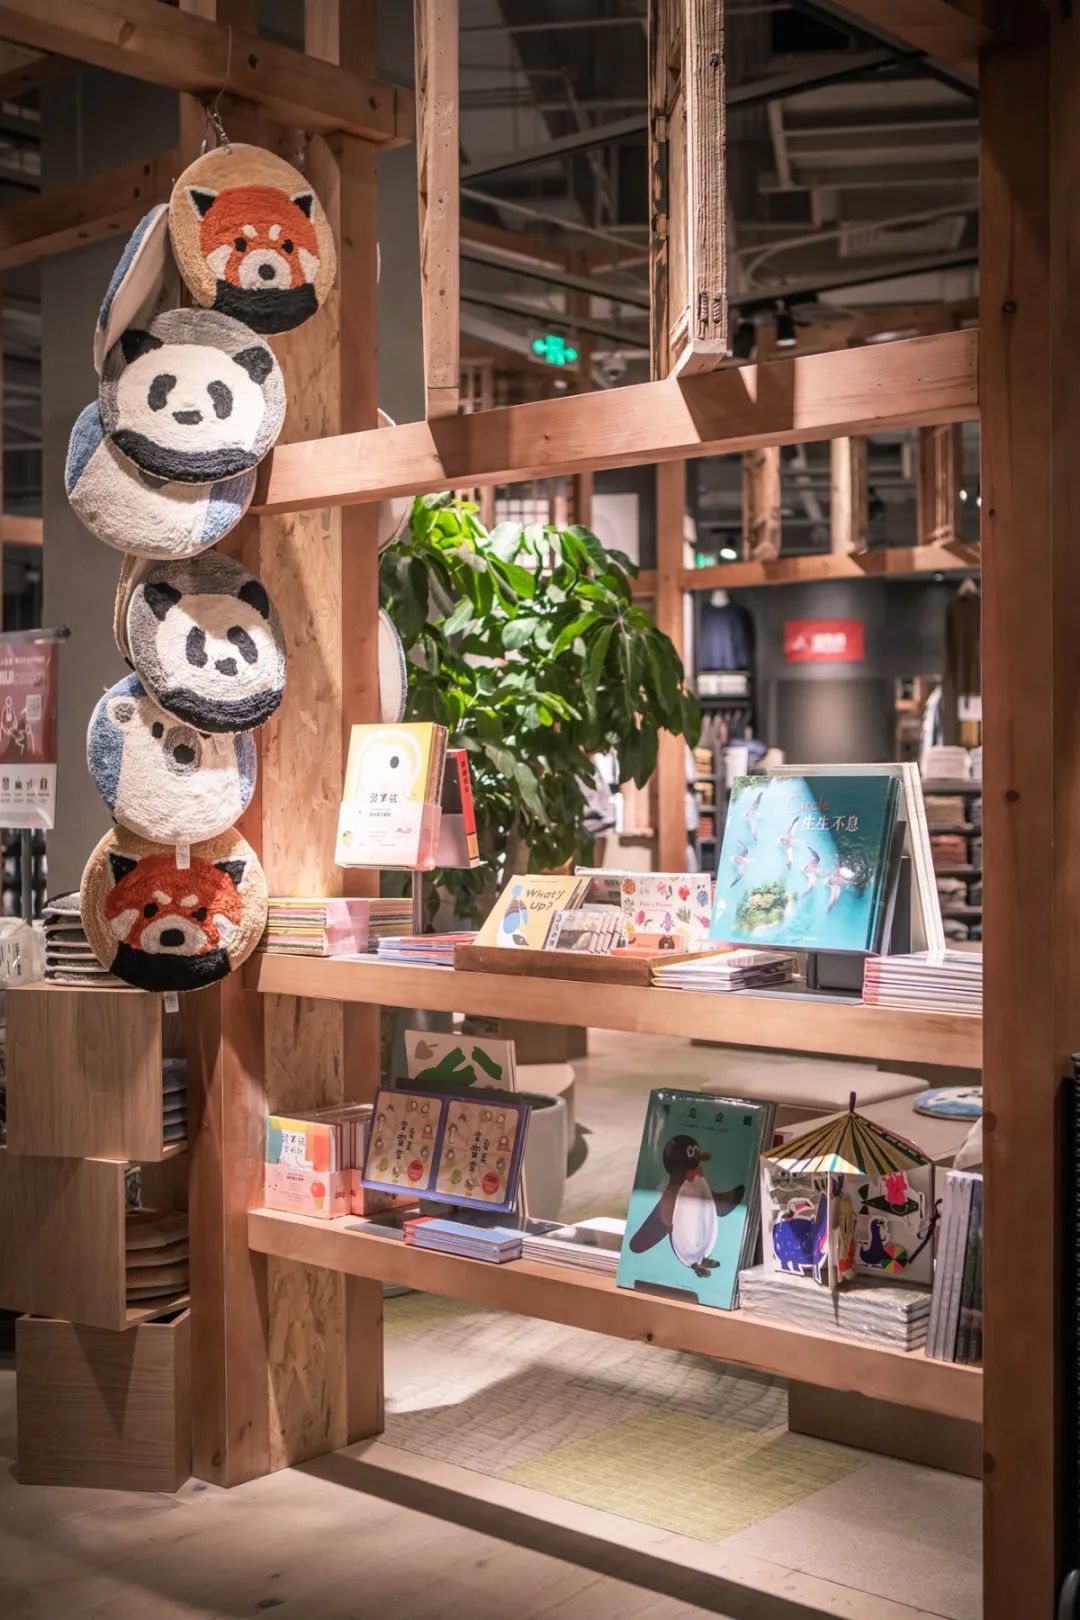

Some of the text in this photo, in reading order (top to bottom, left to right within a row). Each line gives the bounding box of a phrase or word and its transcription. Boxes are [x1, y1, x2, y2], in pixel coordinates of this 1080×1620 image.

[786, 793, 832, 813] Circle
[802, 815, 859, 833] 生生不息
[526, 888, 566, 901] What's
